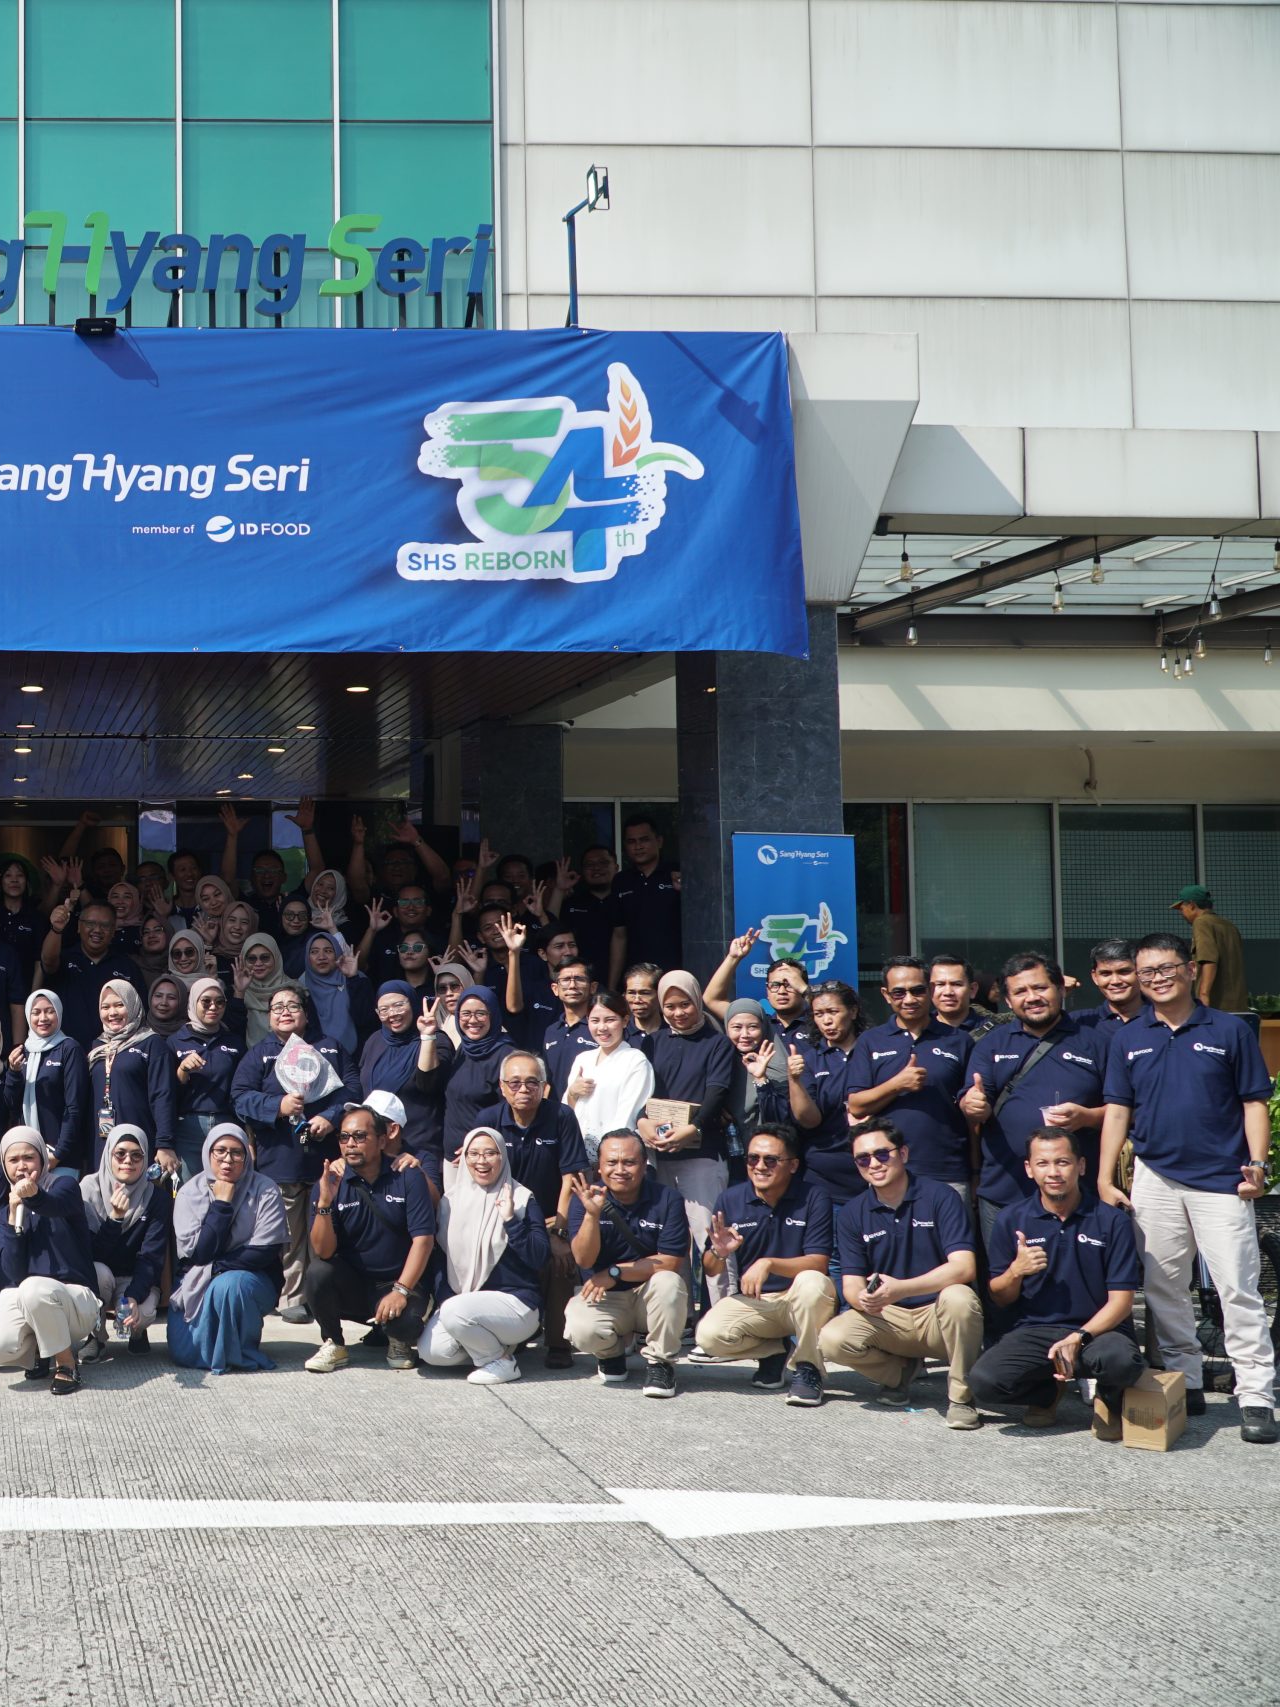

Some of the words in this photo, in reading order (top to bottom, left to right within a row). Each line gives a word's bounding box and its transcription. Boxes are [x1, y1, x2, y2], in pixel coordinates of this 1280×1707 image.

[318, 213, 493, 298] Seri
[224, 454, 310, 492] Seri
[132, 524, 181, 534] member
[183, 524, 195, 534] of
[407, 552, 456, 571] SHS
[464, 549, 566, 571] REBORN
